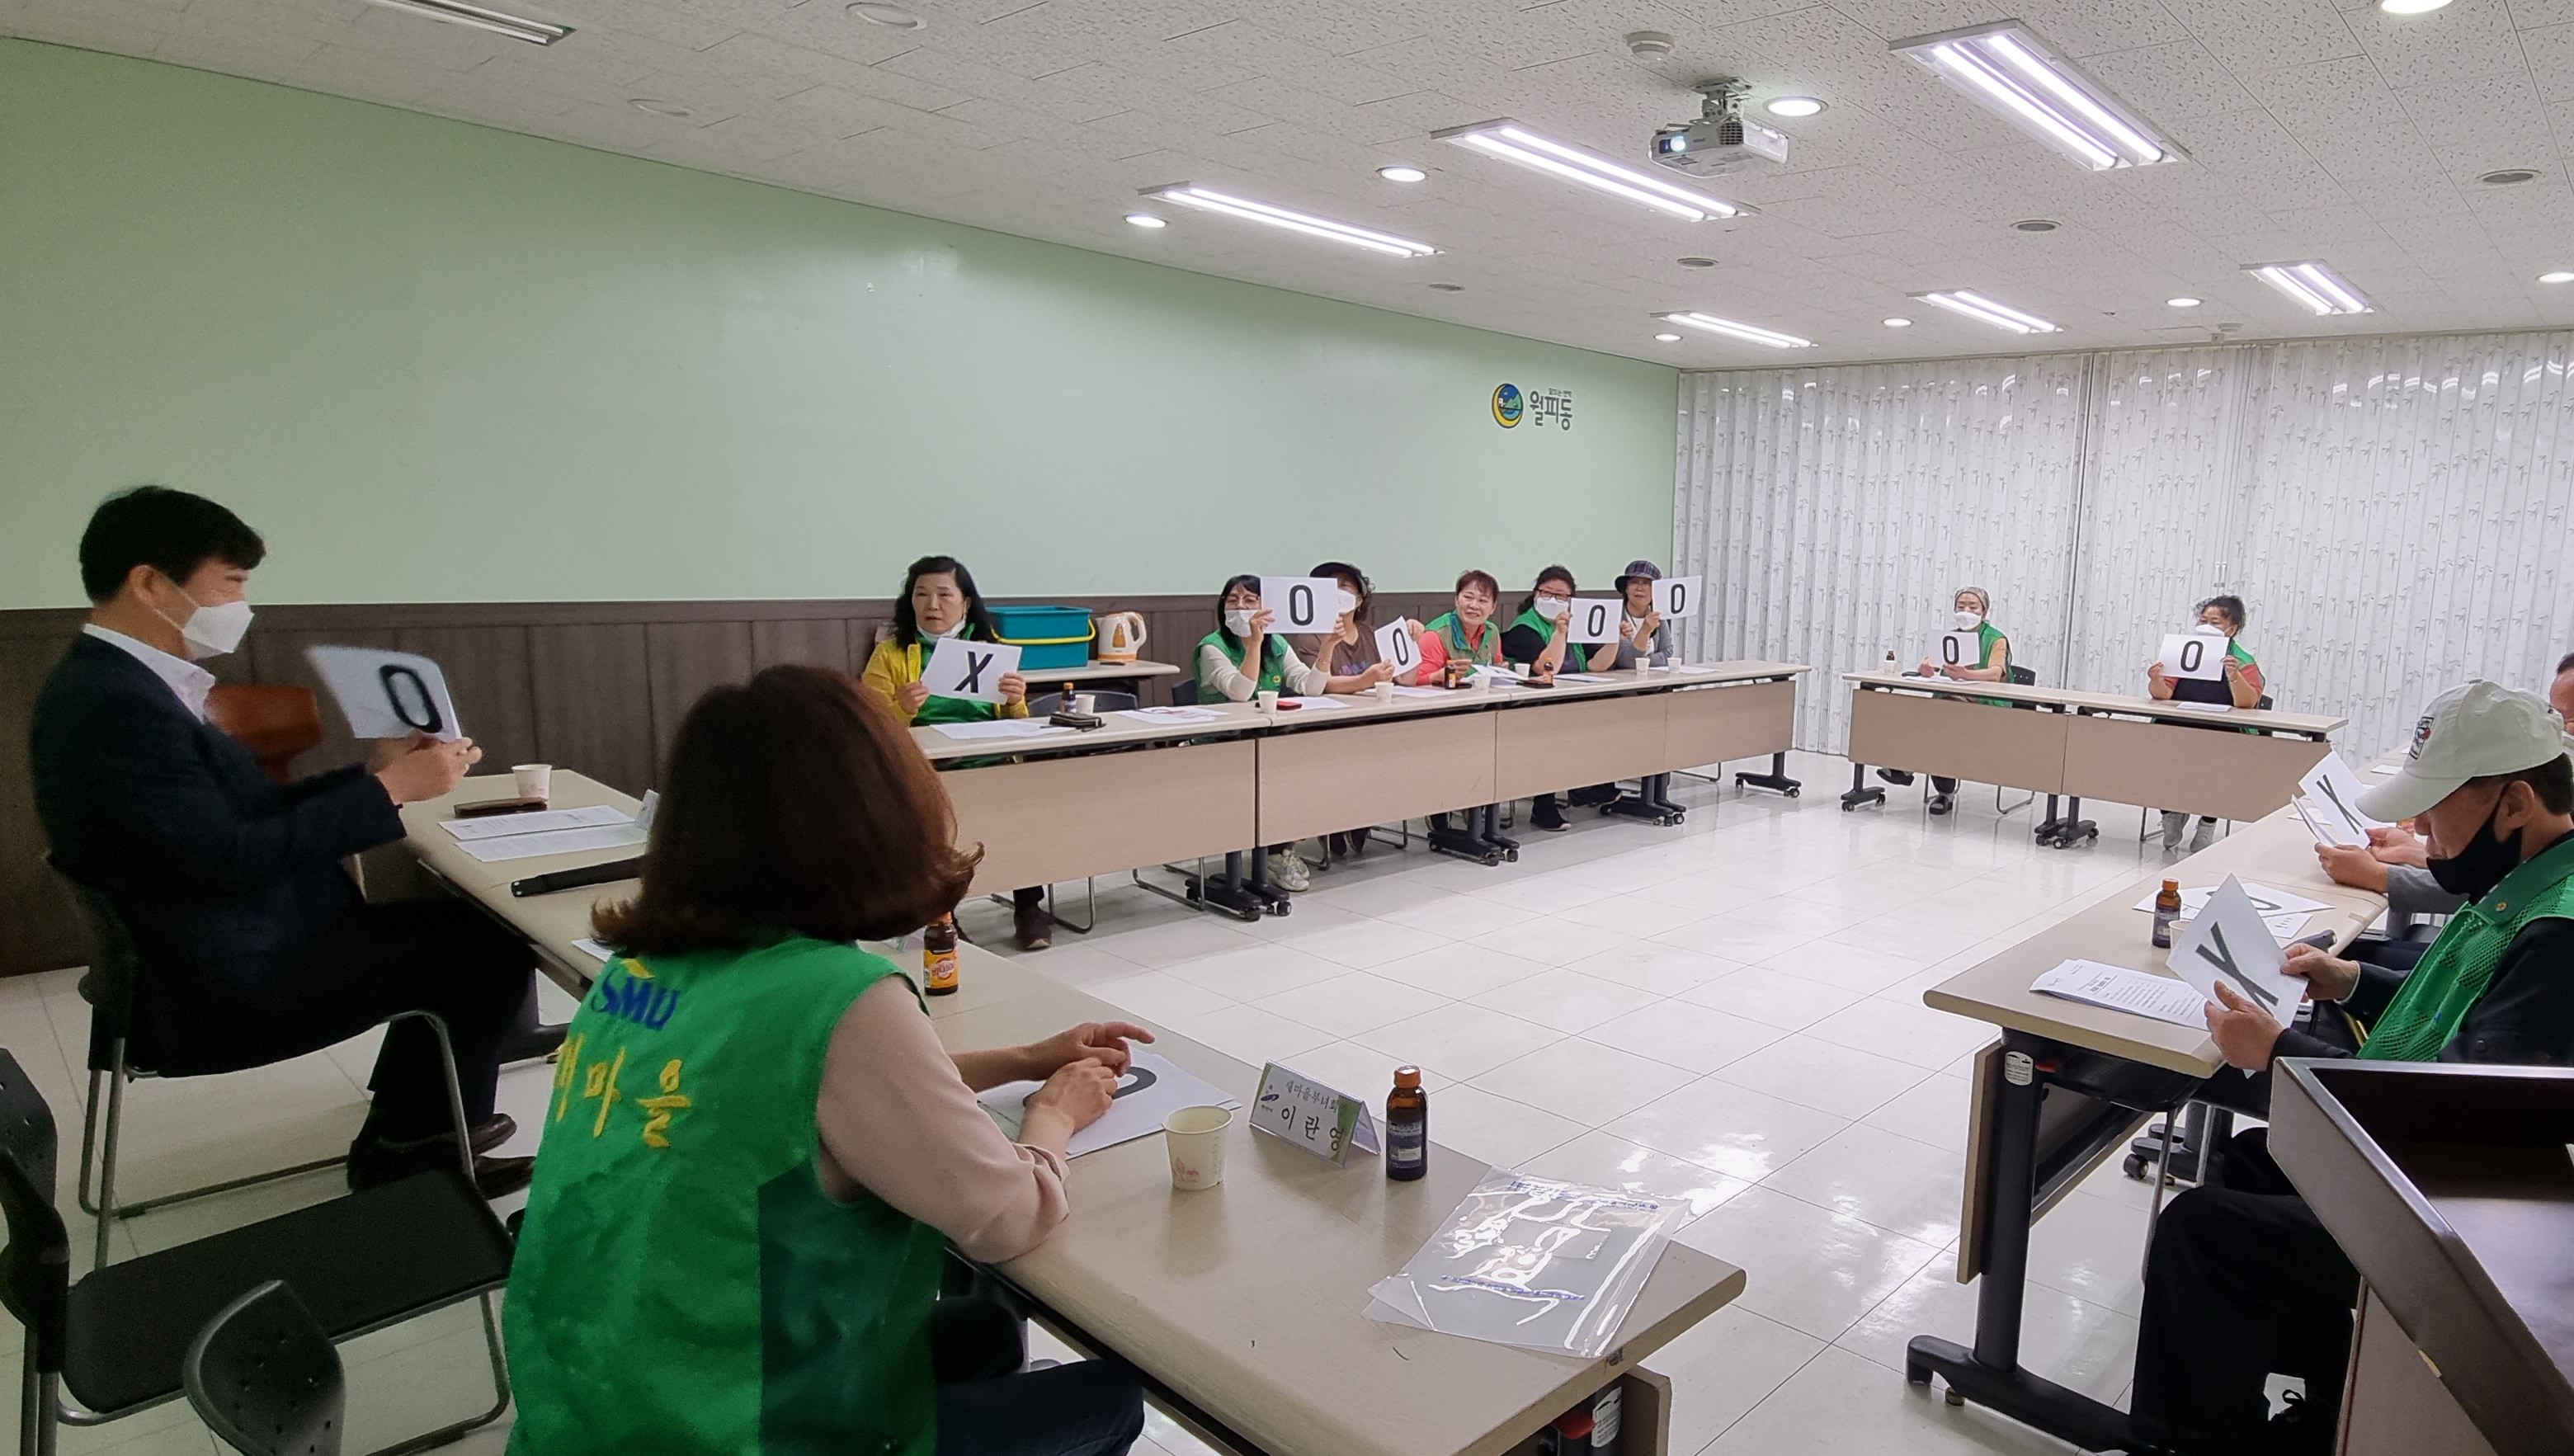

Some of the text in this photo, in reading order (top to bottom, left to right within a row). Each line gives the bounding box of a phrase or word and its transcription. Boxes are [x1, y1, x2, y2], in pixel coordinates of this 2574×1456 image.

[1530, 390, 1572, 431] 월피동
[954, 652, 993, 693] X
[591, 968, 680, 1030] SMU
